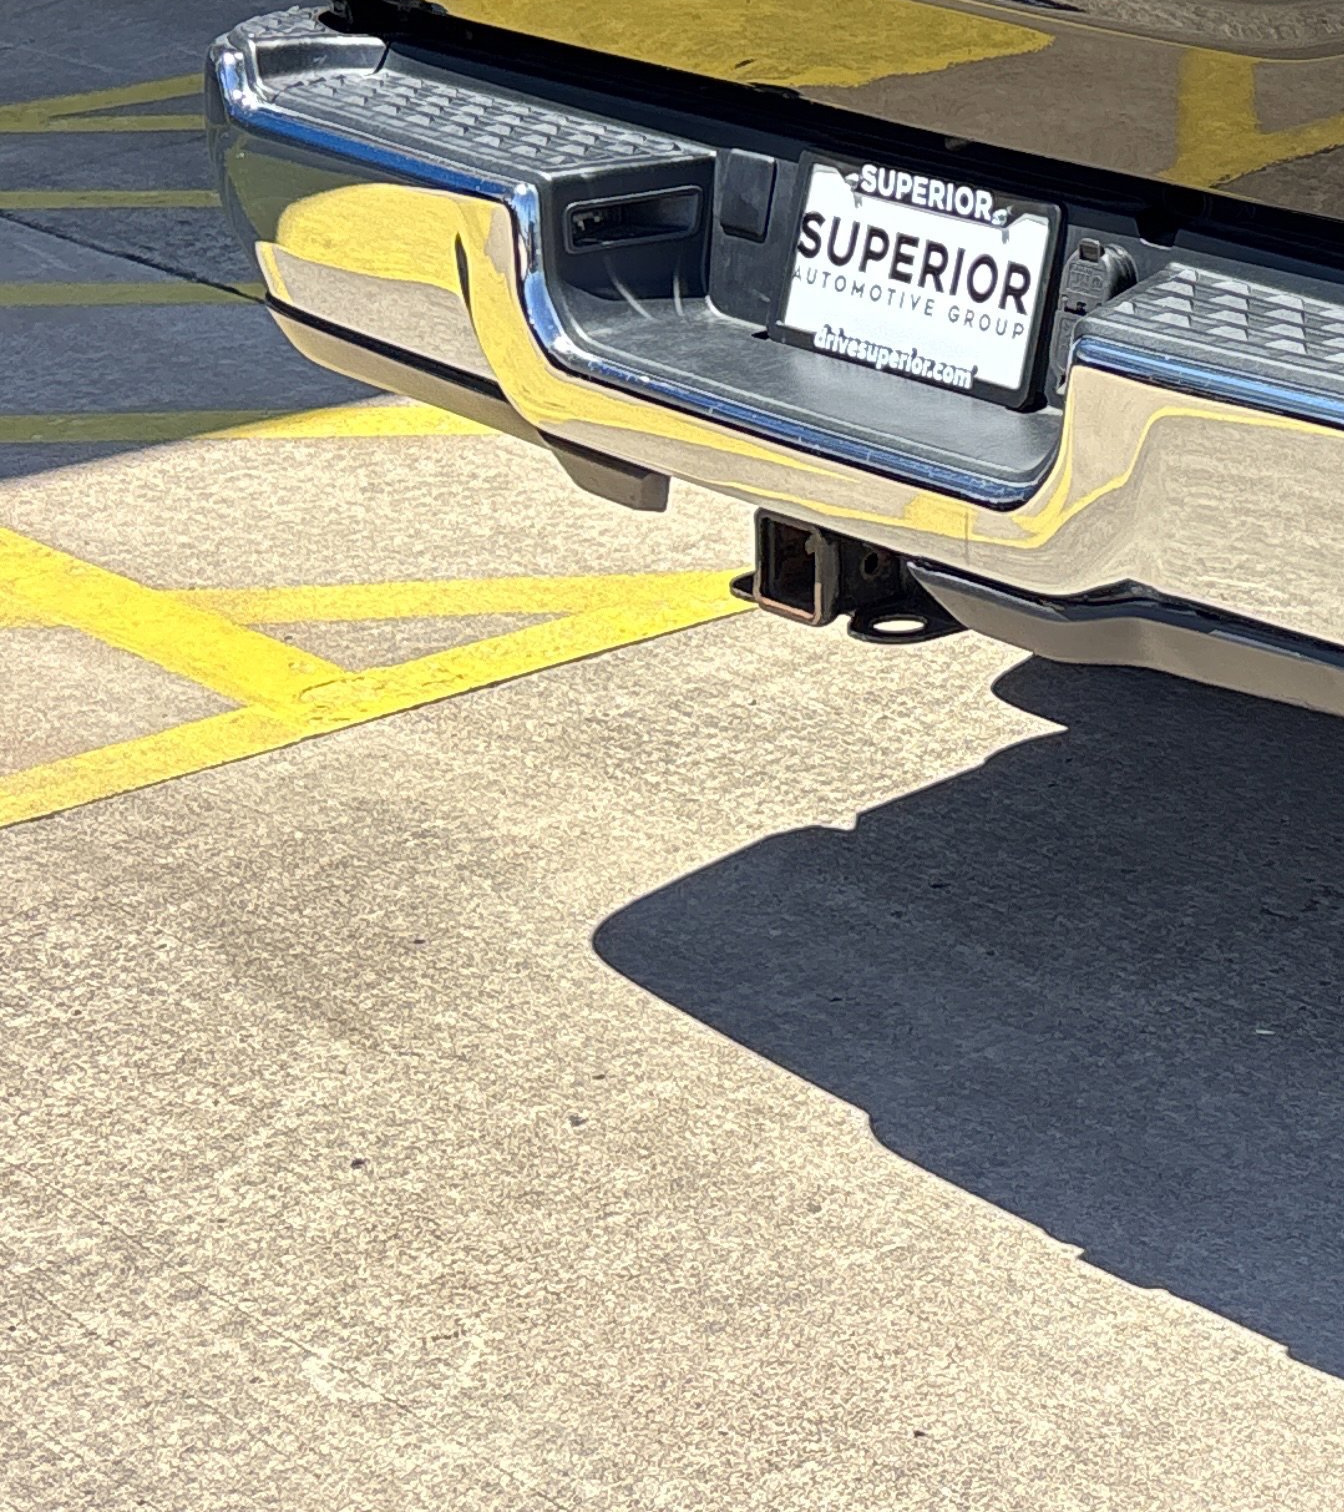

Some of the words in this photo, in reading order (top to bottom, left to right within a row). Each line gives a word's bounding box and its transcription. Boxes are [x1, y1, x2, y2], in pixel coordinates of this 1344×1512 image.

[859, 164, 994, 223] SUPERIOR
[796, 211, 1032, 316] SUPERIOR
[792, 265, 936, 317] AUTOMOTIVE
[947, 305, 1025, 340] GROUP
[813, 324, 977, 389] drivesuperior.com
